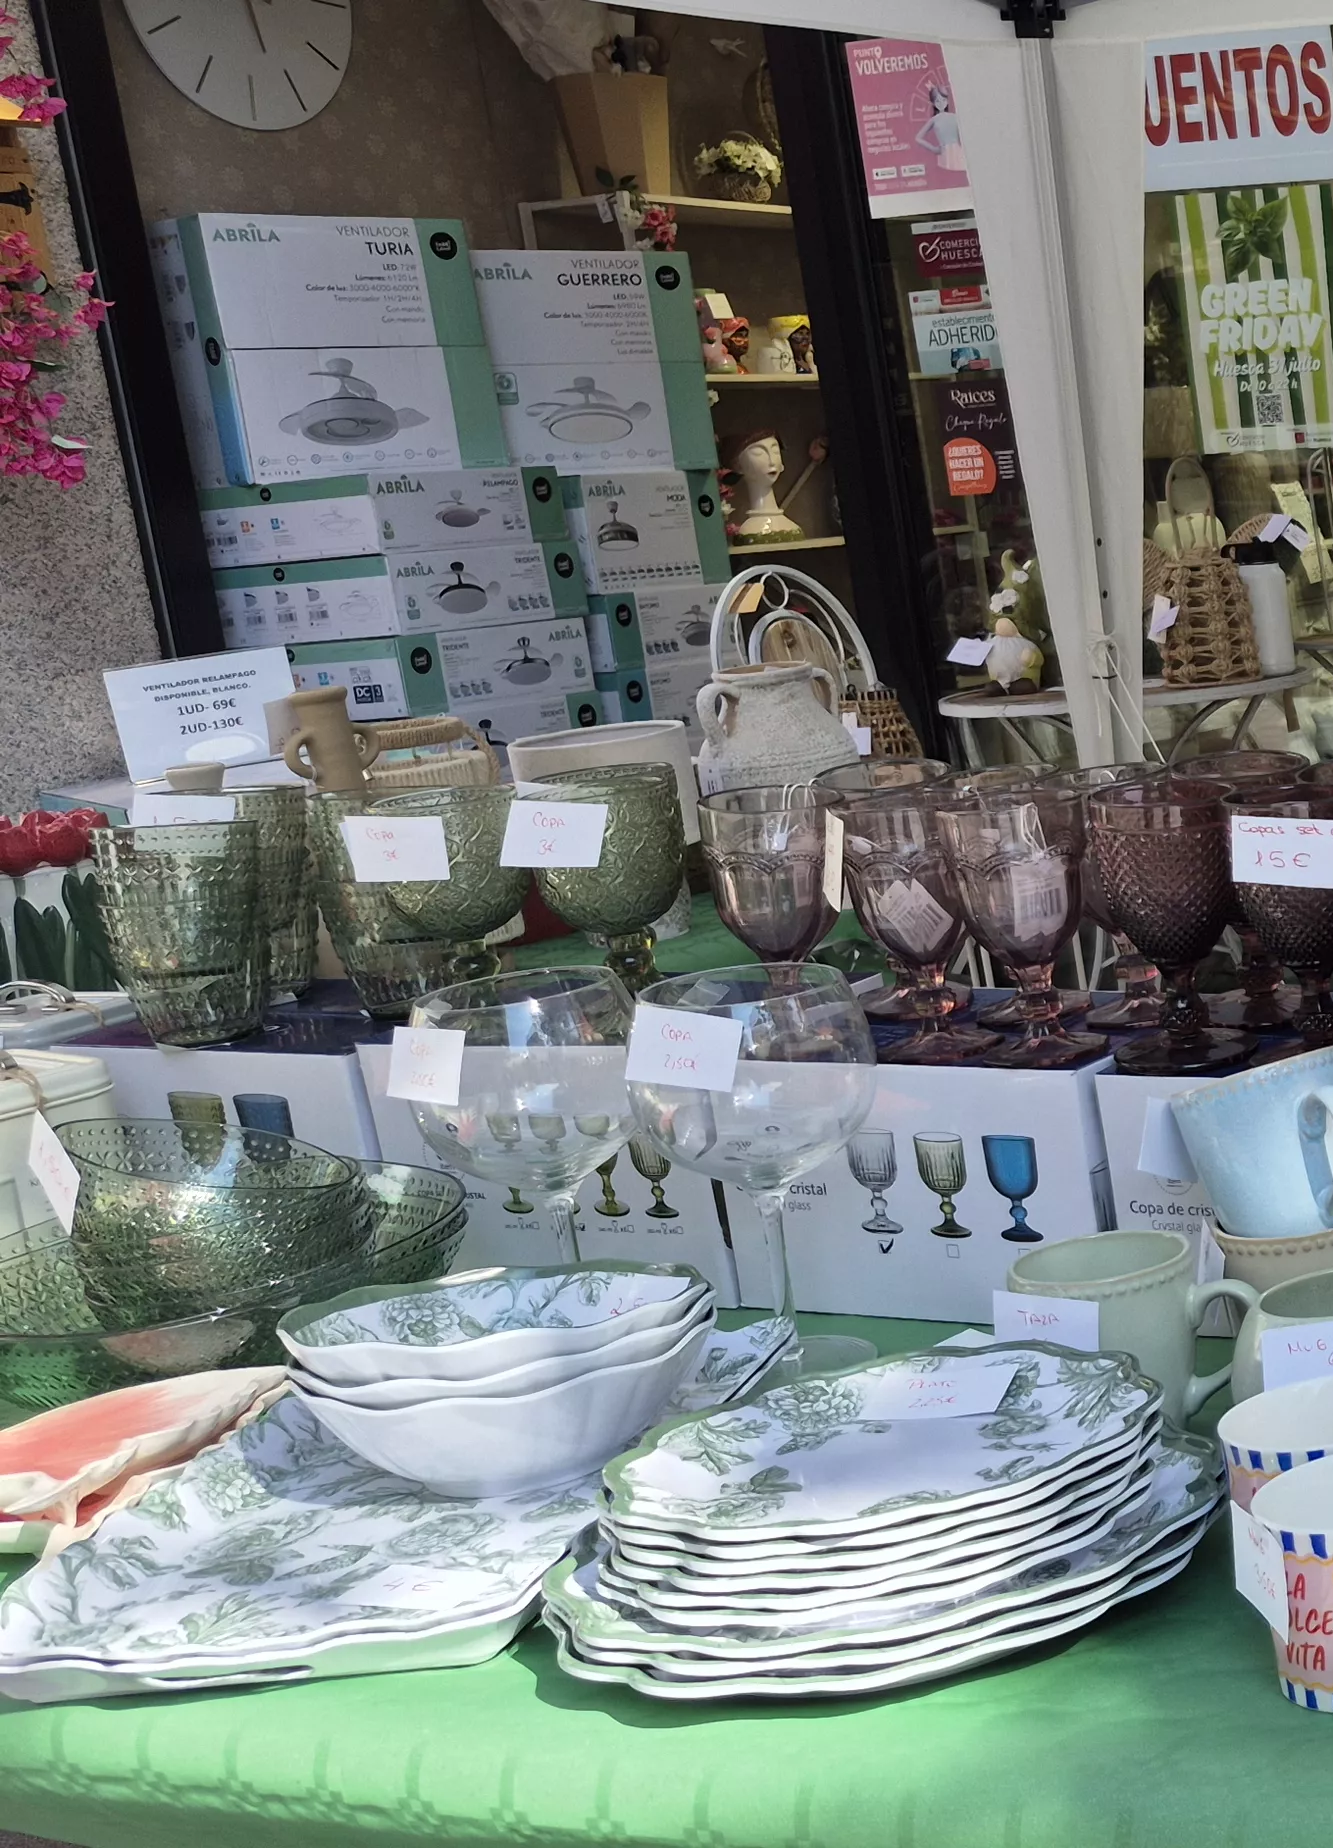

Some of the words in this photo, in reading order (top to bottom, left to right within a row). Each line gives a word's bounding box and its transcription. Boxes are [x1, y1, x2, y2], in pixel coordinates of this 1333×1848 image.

[855, 53, 929, 76] VOLVEREMOS
[1145, 41, 1332, 147] UENTOS
[336, 225, 409, 238] VENTILADOR
[365, 242, 413, 256] TURIA
[940, 238, 979, 250] COMERCI
[571, 259, 639, 269] VENTILADOR
[557, 273, 642, 287] GUERRERO
[1201, 278, 1313, 318] GREEN
[929, 324, 998, 347] ADHERID
[1200, 313, 1324, 354] FRIDAY
[1214, 360, 1265, 377] Huesca
[1287, 356, 1321, 374] julio
[142, 679, 200, 692] VENTILADOR
[202, 669, 257, 683] RELAMPAGO
[154, 688, 210, 702] DISPONIBLE,
[212, 683, 251, 693] BLANCO.
[355, 686, 371, 698] DC
[177, 702, 210, 716] 1UD-
[212, 698, 237, 711] 69€
[179, 716, 244, 735] 2UD-130€
[1296, 824, 1323, 836] set
[789, 1182, 827, 1196] cristal
[788, 1200, 811, 1212] glass
[1130, 1200, 1164, 1217] Copa
[1168, 1203, 1184, 1216] de
[1152, 1220, 1184, 1232] Crystal
[1288, 1608, 1333, 1635] LCE
[1286, 1643, 1325, 1671] VITA
